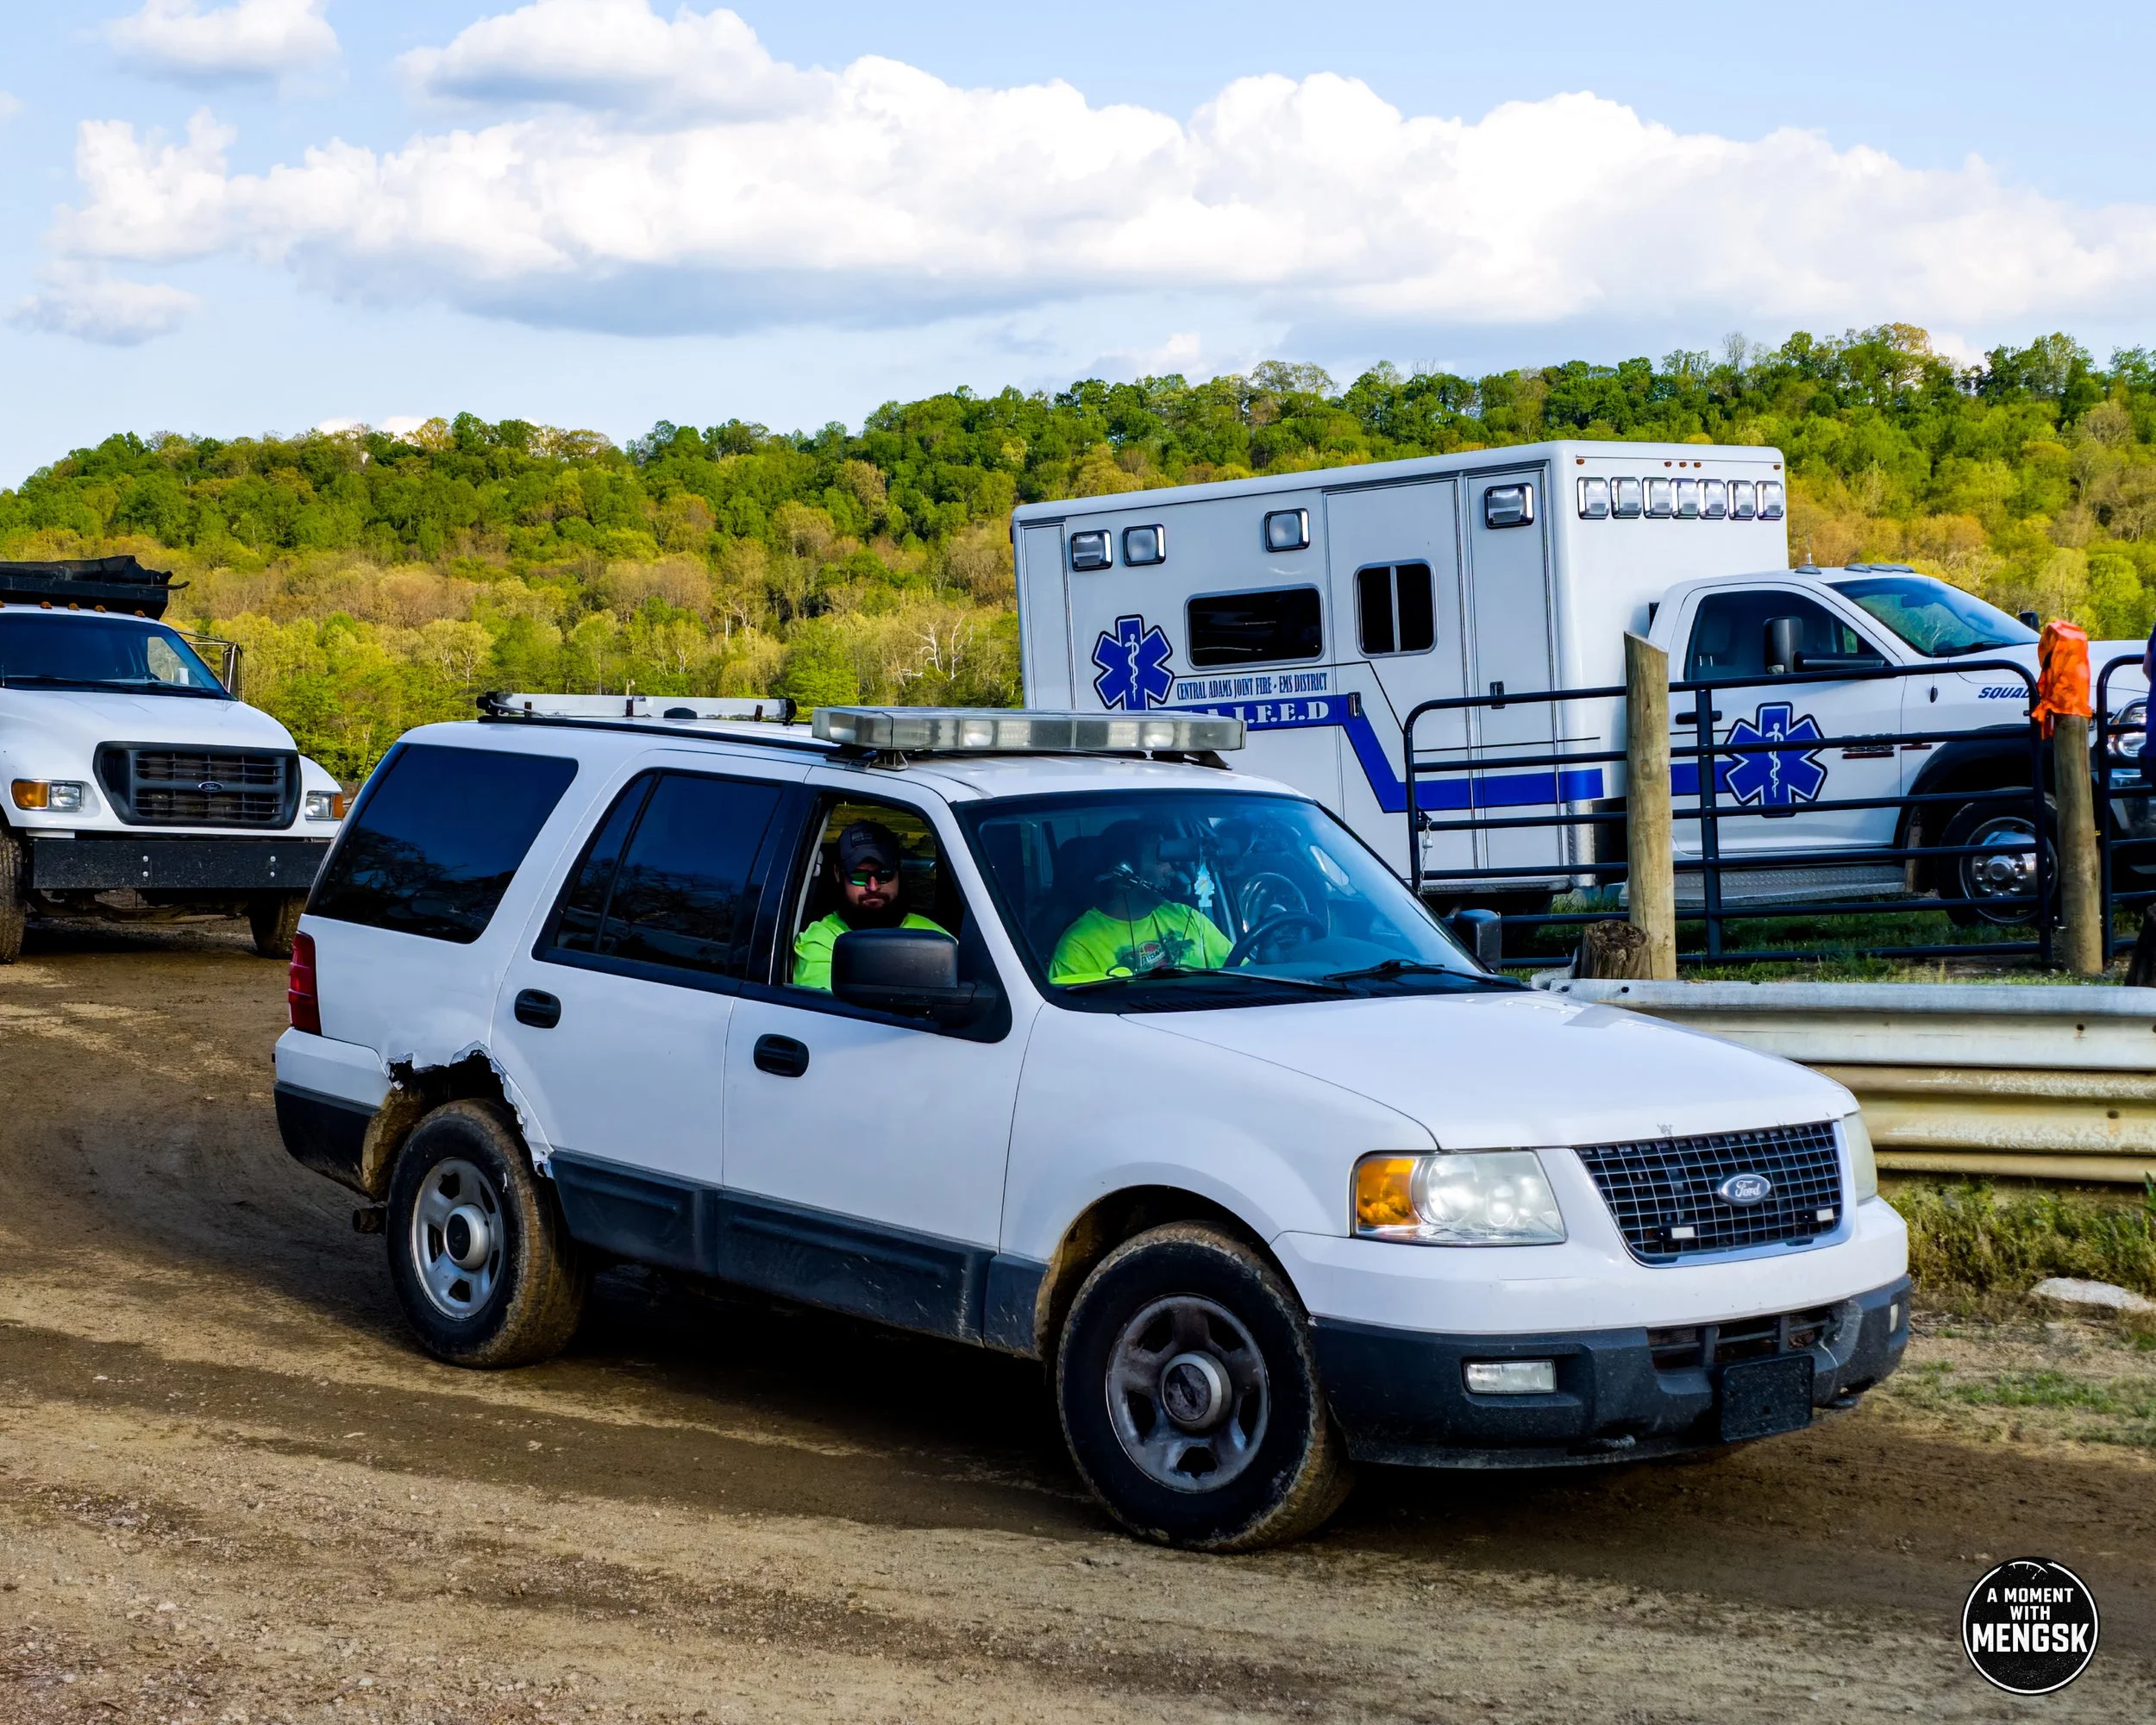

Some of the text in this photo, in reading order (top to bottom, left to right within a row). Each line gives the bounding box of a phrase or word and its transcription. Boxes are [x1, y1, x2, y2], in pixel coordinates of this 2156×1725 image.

[1176, 681, 1206, 700] CENTRAL
[1208, 679, 1232, 699] ADAMS
[1233, 678, 1253, 699] JOINT
[1256, 676, 1272, 695] FIRE
[1279, 674, 1293, 693] EMS
[1294, 672, 1327, 693] DISTRICT
[1734, 1180, 1762, 1197] Ford
